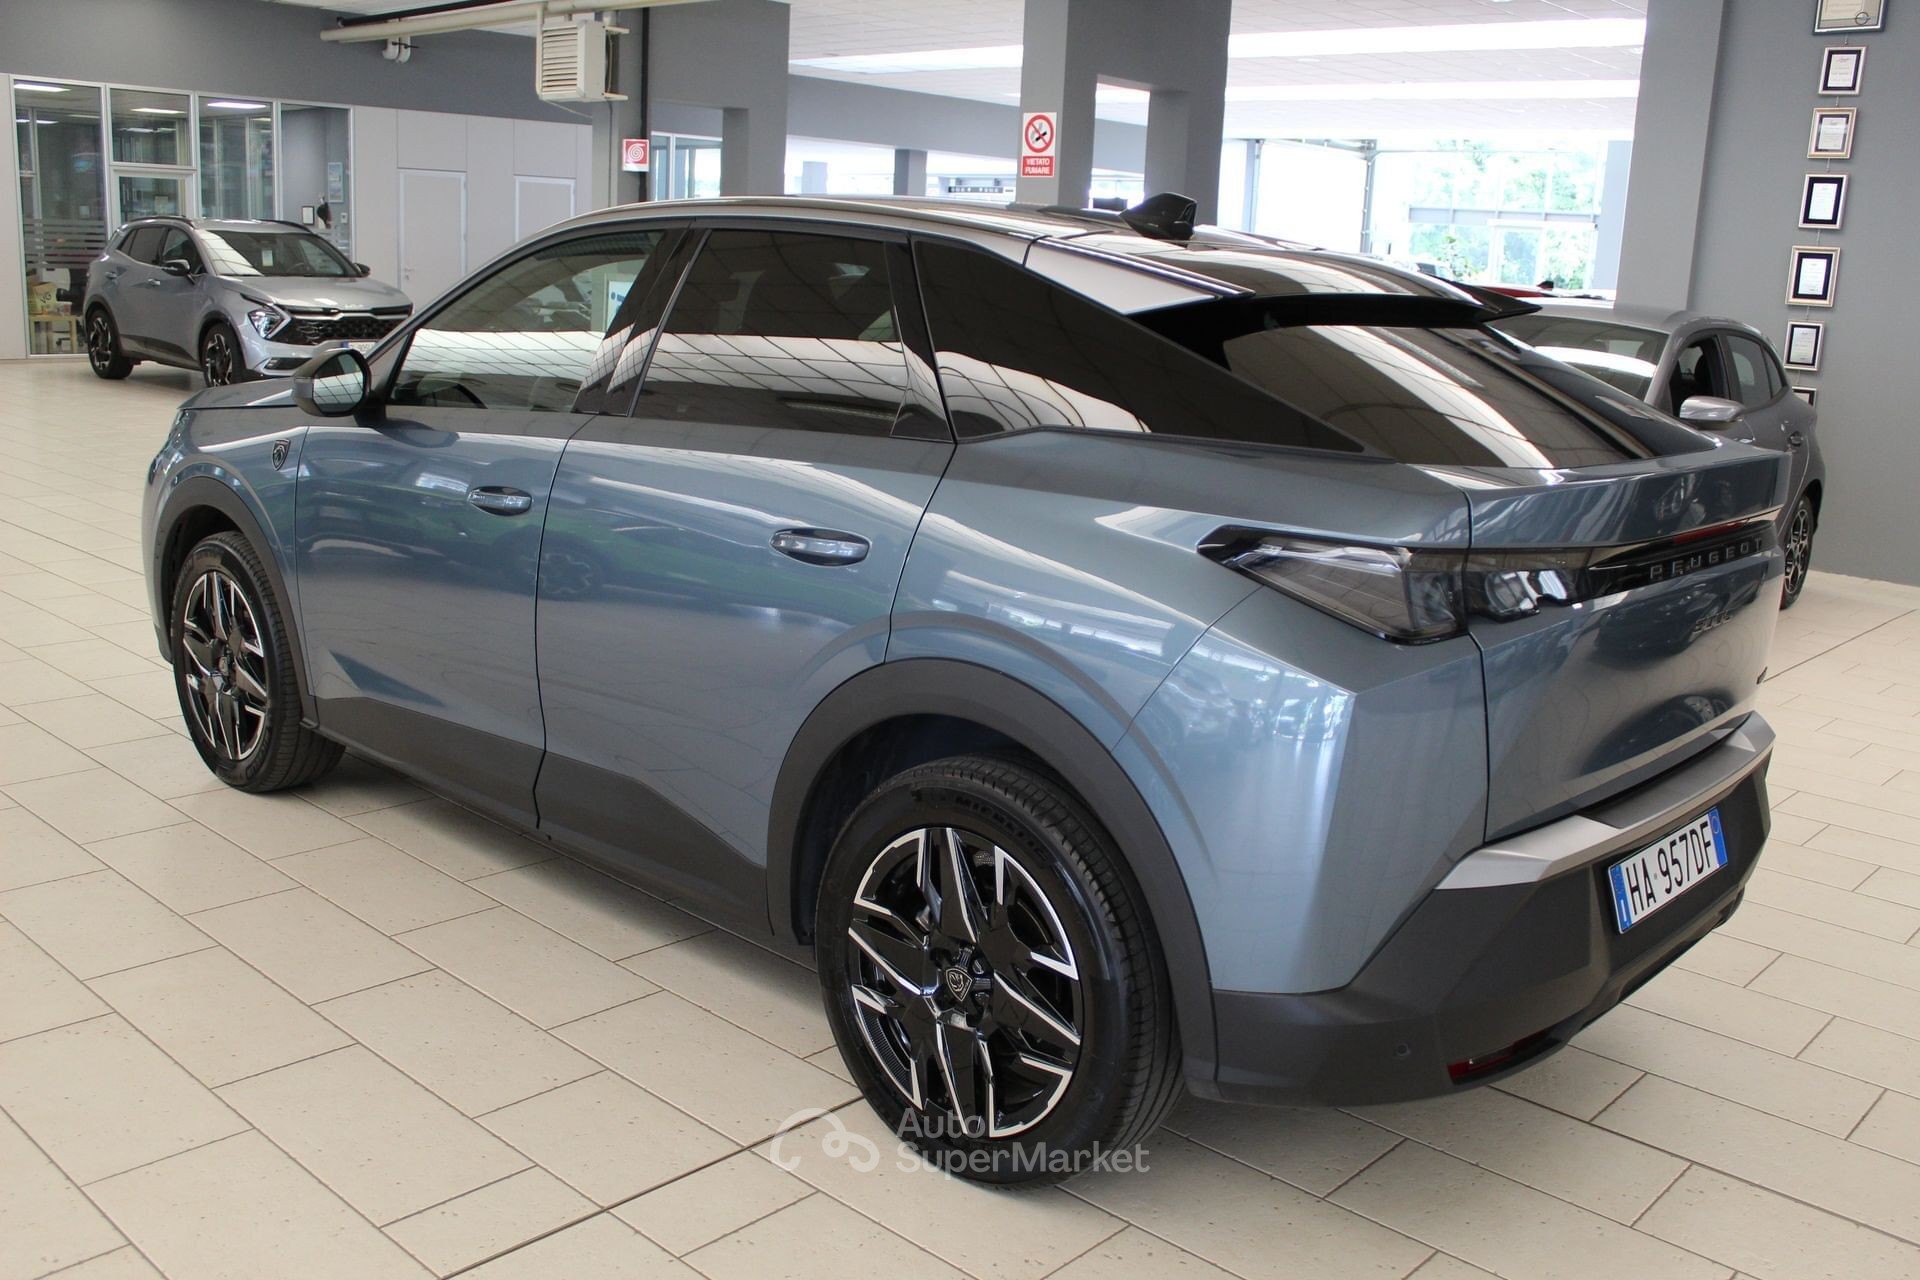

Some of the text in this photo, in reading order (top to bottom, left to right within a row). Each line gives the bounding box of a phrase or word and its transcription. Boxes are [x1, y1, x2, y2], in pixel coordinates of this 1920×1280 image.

[1024, 166, 1051, 175] FUMARE
[1025, 157, 1051, 166] VIETATO
[1650, 537, 1762, 580] PEUGEOT
[1625, 856, 1657, 916] HA
[1657, 820, 1712, 895] 957DF
